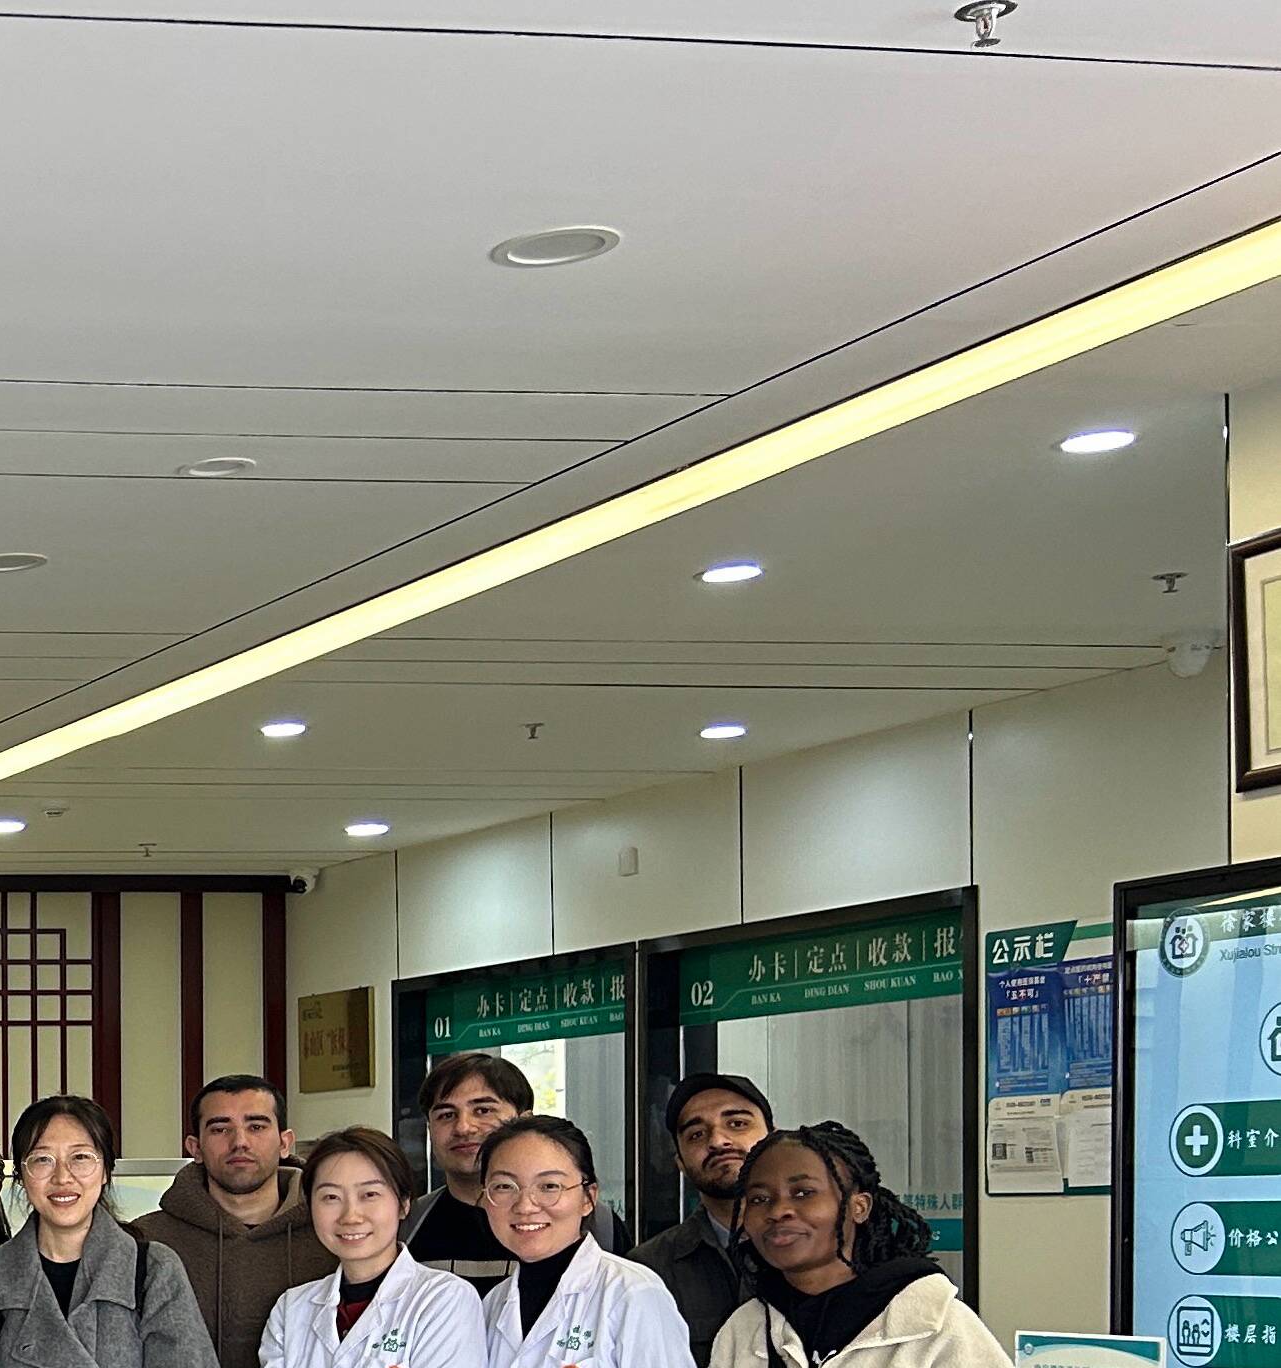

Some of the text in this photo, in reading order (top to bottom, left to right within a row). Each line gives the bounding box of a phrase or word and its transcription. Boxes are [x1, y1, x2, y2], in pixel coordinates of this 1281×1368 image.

[1221, 906, 1281, 934] 徐家楼
[744, 925, 963, 983] 办卡 定点 收款 报
[992, 931, 1054, 964] 公示栏
[1220, 941, 1281, 962] Xujialou Str
[691, 980, 714, 1006] 02
[804, 987, 826, 999] DING
[827, 983, 850, 996] DIAN
[863, 979, 887, 992] SHOU
[889, 974, 917, 989] KUAN
[933, 969, 953, 983] BAO
[477, 991, 505, 1018] 办卡
[519, 986, 548, 1012] 定点
[563, 978, 594, 1008] 收款
[434, 1016, 451, 1038] 01
[1226, 1128, 1280, 1150] 科室介
[1228, 1226, 1280, 1249] 价格公
[1224, 1321, 1277, 1346] 楼层指
